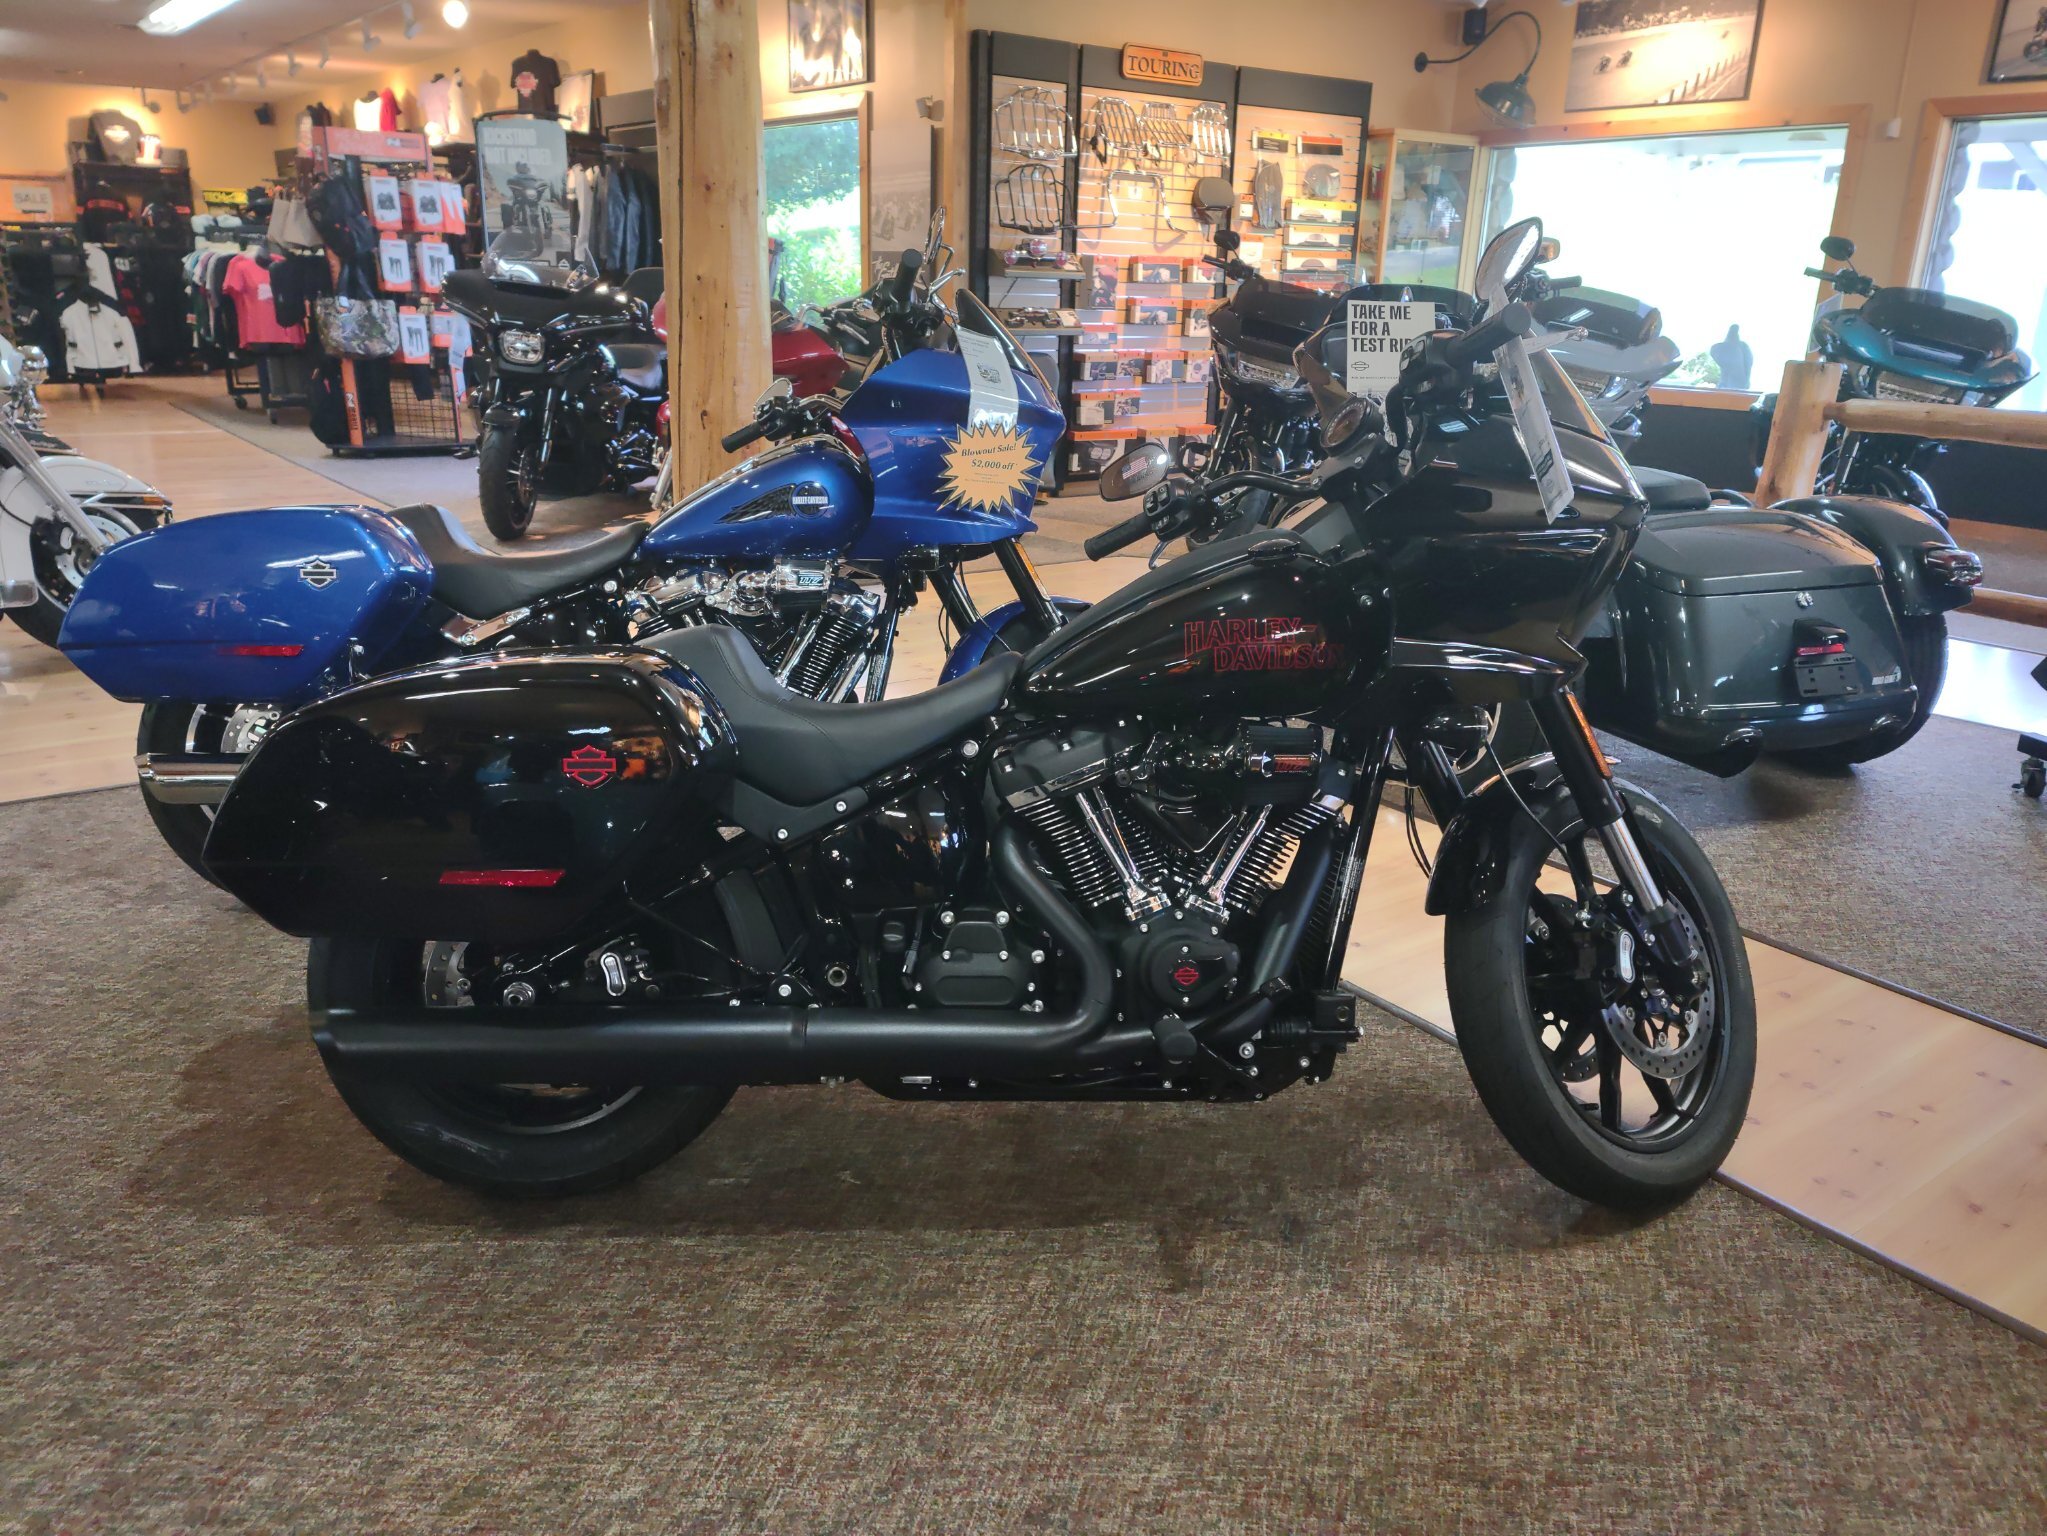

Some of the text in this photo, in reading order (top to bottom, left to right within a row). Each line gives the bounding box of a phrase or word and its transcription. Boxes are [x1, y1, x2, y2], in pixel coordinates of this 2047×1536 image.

[1127, 55, 1200, 80] TOURING
[13, 192, 49, 205] SALE
[1351, 304, 1411, 320] TAKE ME
[1351, 321, 1391, 336] FOR A
[1351, 337, 1412, 353] TEST RI
[961, 442, 1017, 457] Blowout Sale!
[971, 459, 1001, 470] $2,000
[1214, 643, 1346, 673] DAVIDSON
